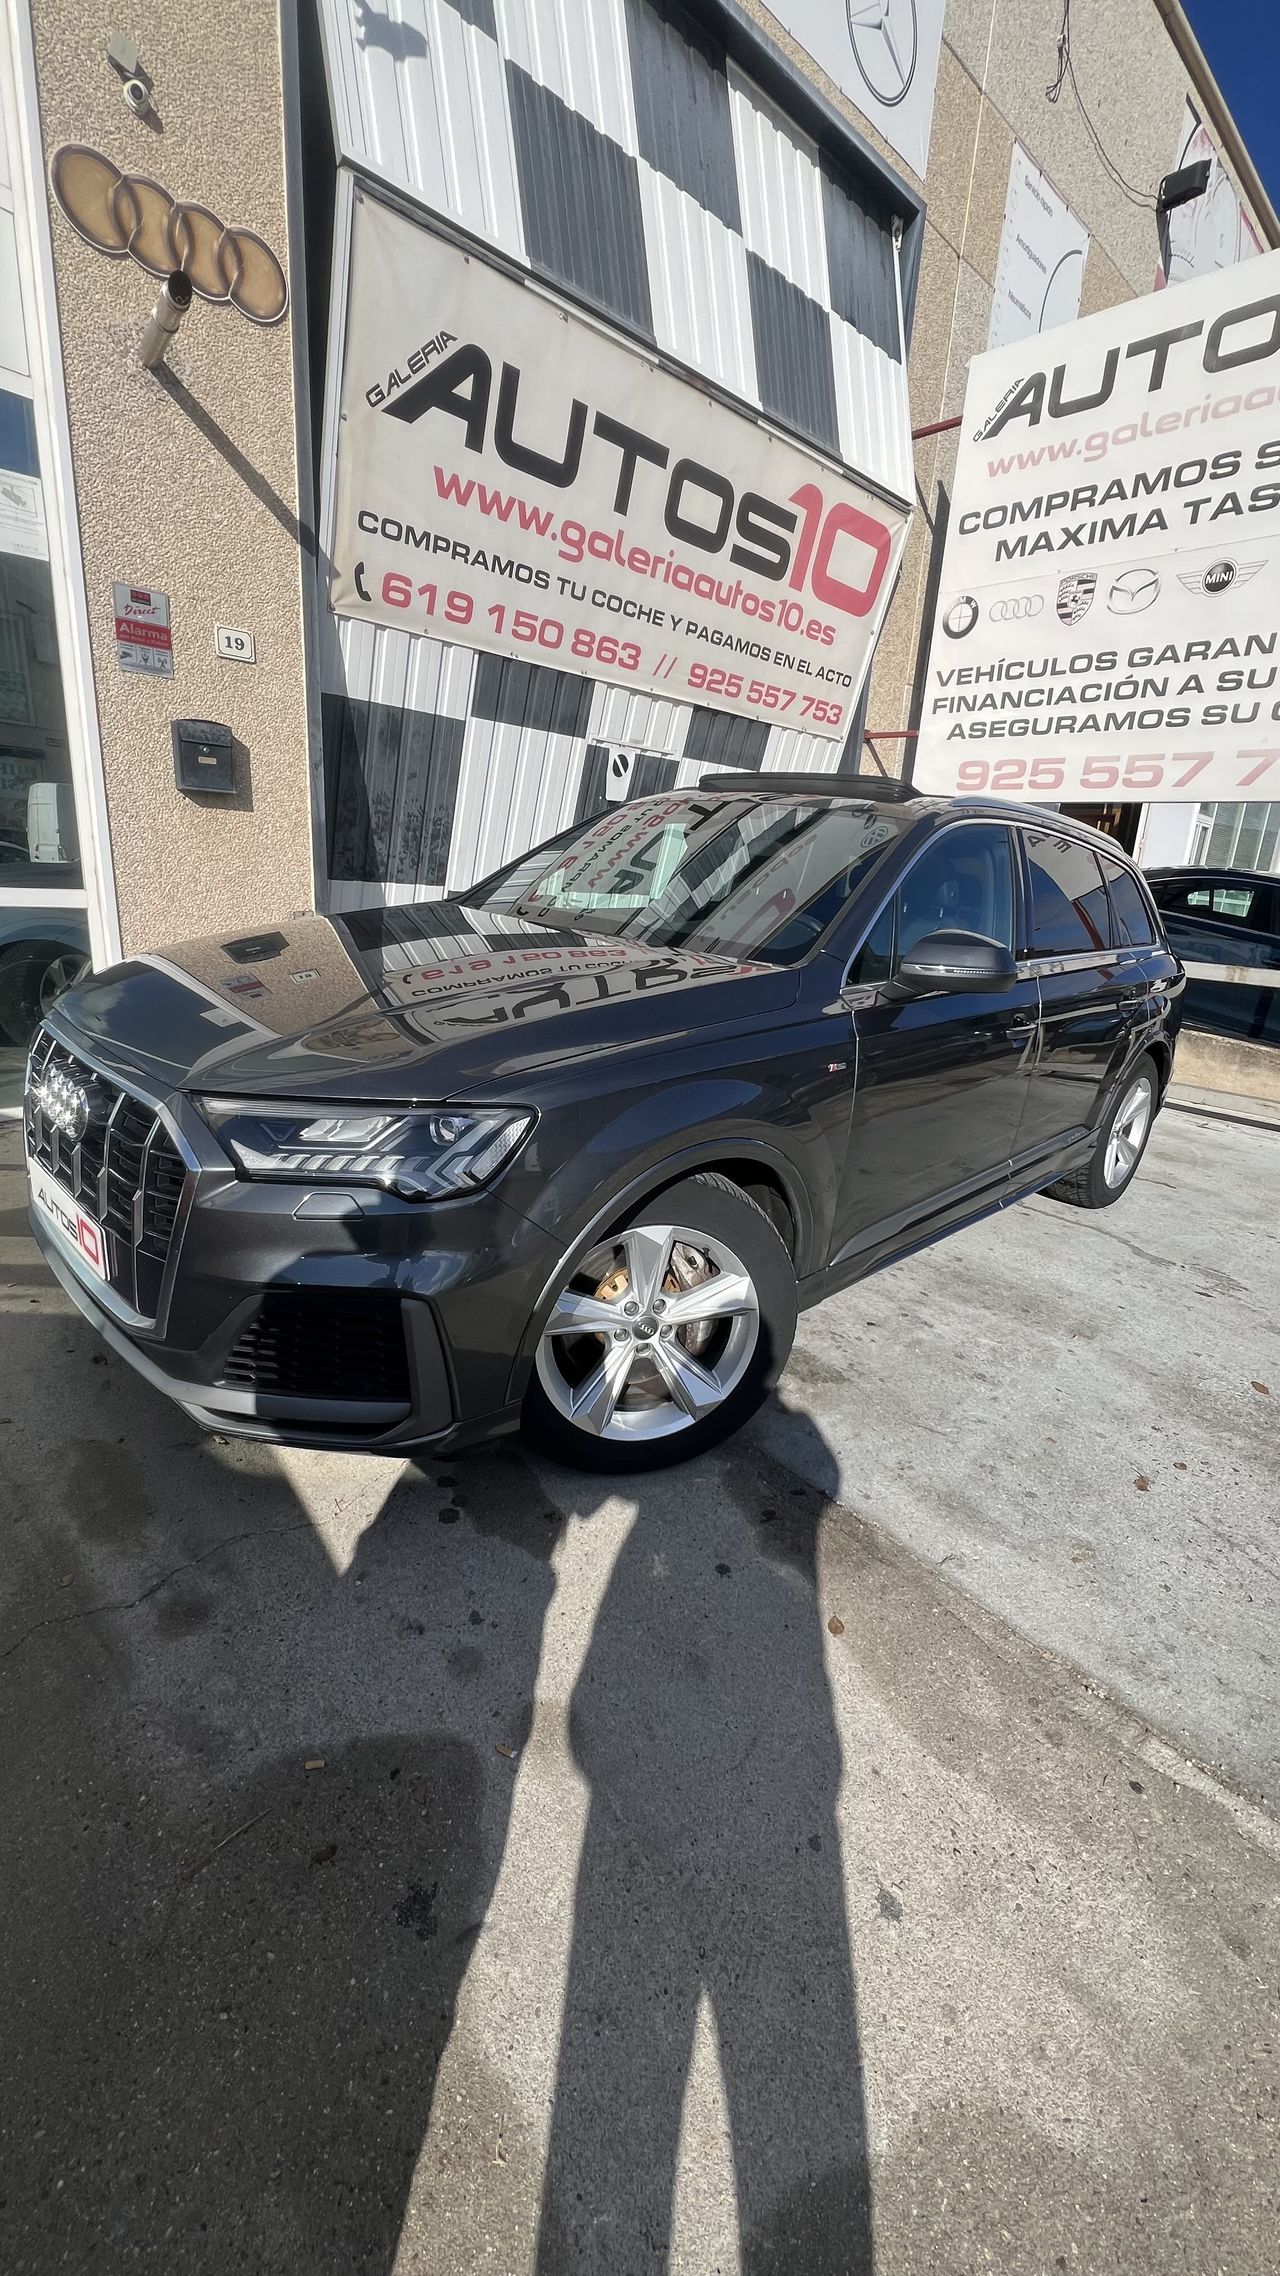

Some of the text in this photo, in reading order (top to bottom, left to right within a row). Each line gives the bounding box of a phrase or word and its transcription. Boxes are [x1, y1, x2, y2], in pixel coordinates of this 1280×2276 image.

[365, 330, 458, 407] GALERIA
[972, 377, 1025, 443] GALERIA
[988, 386, 1280, 478] www.galeriaa
[959, 450, 1242, 535] COMPRAMOS
[995, 482, 1280, 562] MAXIMA TAS
[433, 465, 837, 646] www.galeriaautos10.es
[1205, 570, 1234, 584] MINI
[123, 603, 161, 616] Direct
[358, 510, 852, 688] COMPRAMOS TU COCHE Y PAGAMOS EN EL ACTO
[119, 622, 168, 640] Alarma
[225, 635, 245, 651] 19
[381, 571, 474, 625] 619
[488, 603, 565, 649] 150
[571, 628, 642, 671] 863
[687, 662, 744, 699] 925
[746, 680, 797, 713] 557
[799, 695, 843, 725] 753
[936, 632, 1278, 687] VEHÍCULOS GARAN
[932, 666, 1278, 715] FINANCIACIÓN A SU
[946, 707, 1191, 741] ASEGURAMOS
[1200, 702, 1261, 726] SU
[956, 757, 1066, 791] 925
[1079, 751, 1215, 789] 557
